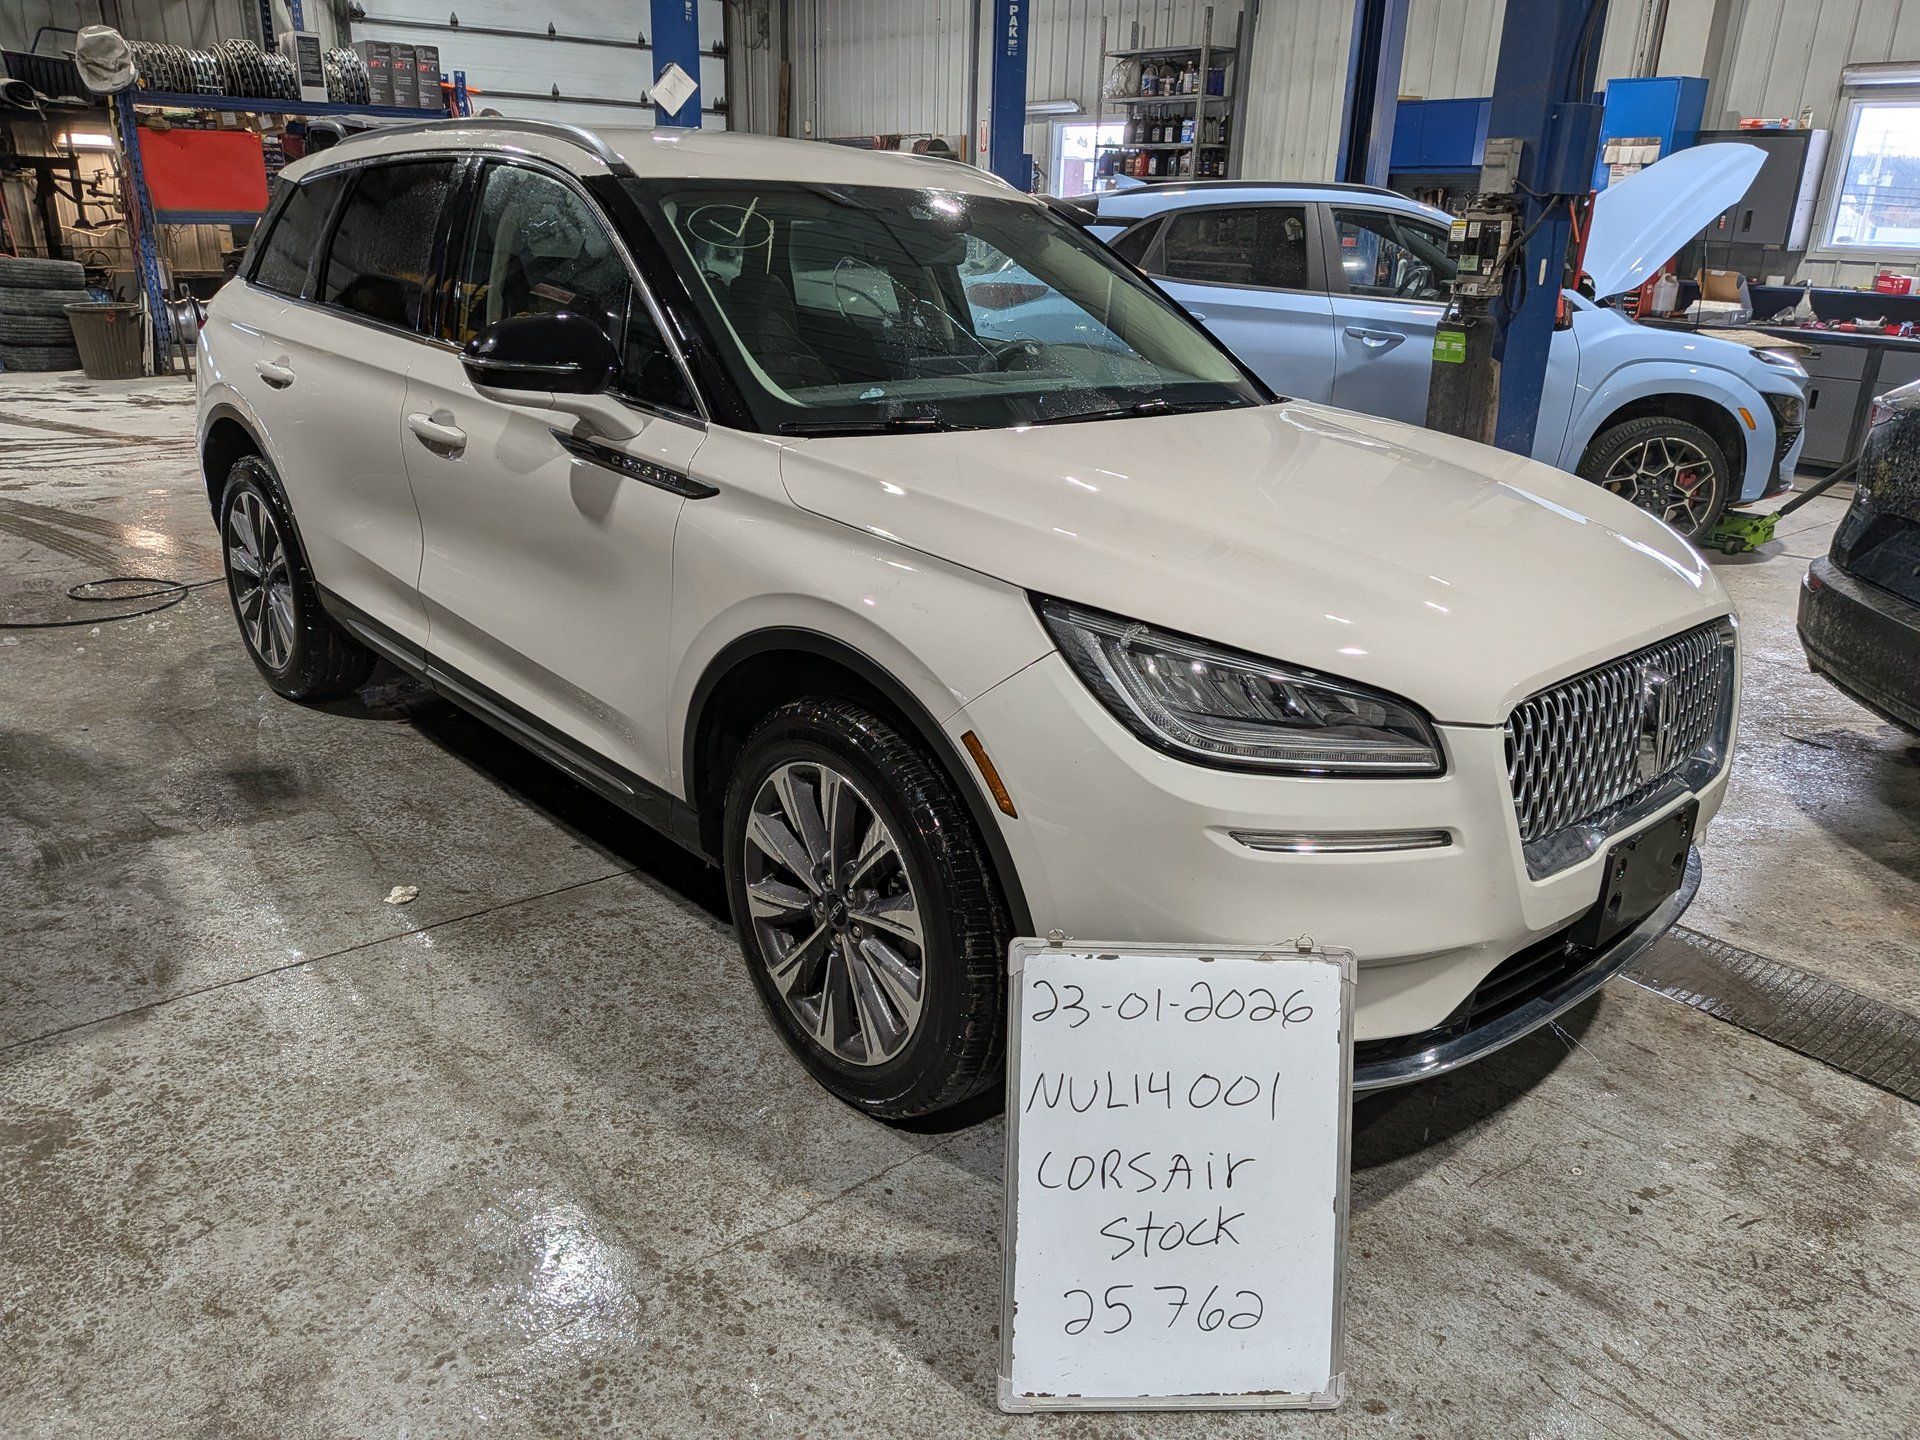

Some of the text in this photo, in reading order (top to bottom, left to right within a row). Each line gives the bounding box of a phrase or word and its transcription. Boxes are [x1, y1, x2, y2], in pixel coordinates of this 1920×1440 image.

[1009, 0, 1018, 37] PAK
[1032, 981, 1313, 1028] 23-01-2026
[1064, 1285, 1263, 1335] 25762
